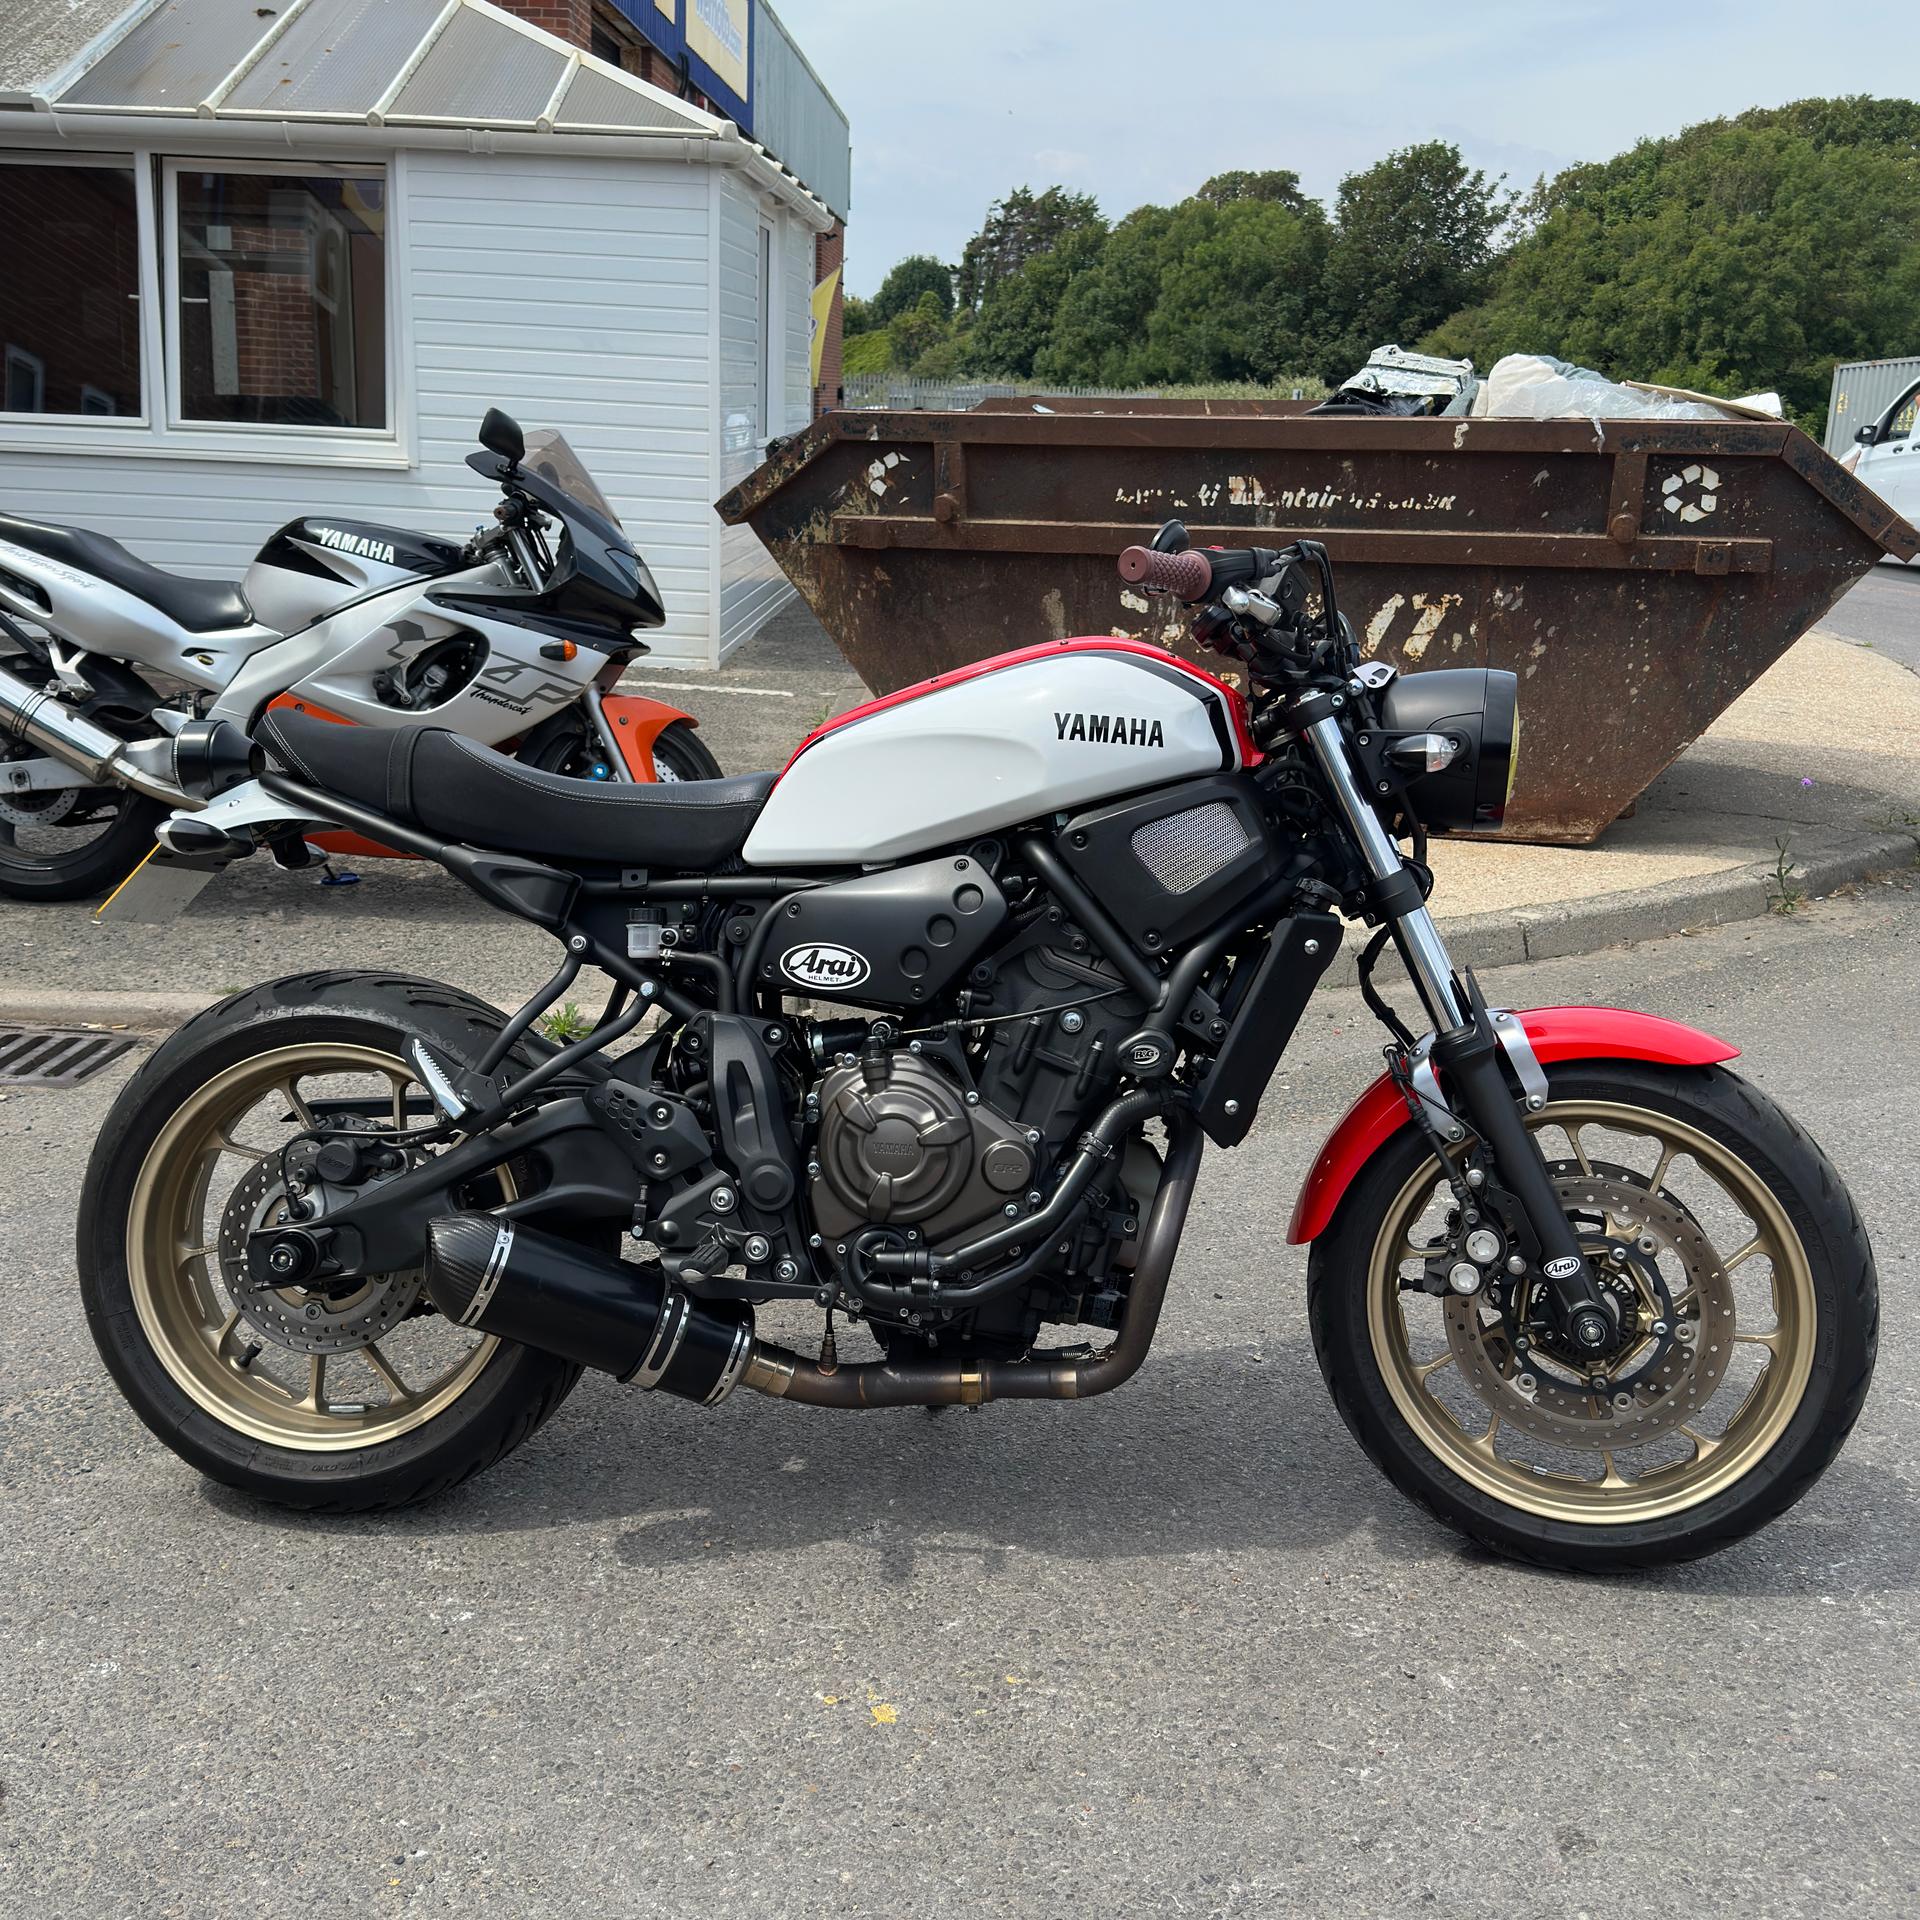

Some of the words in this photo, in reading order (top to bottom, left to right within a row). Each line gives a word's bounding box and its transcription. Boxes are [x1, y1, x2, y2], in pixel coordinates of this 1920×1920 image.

[319, 527, 395, 564] YAMAHA
[470, 687, 534, 715] Thundercat
[1054, 712, 1164, 748] YAMAHA
[788, 949, 858, 977] Arai
[808, 974, 840, 983] HELMET
[1134, 1049, 1155, 1060] R&G
[873, 1142, 914, 1156] YAMAHA
[1548, 1259, 1575, 1274] Arai
